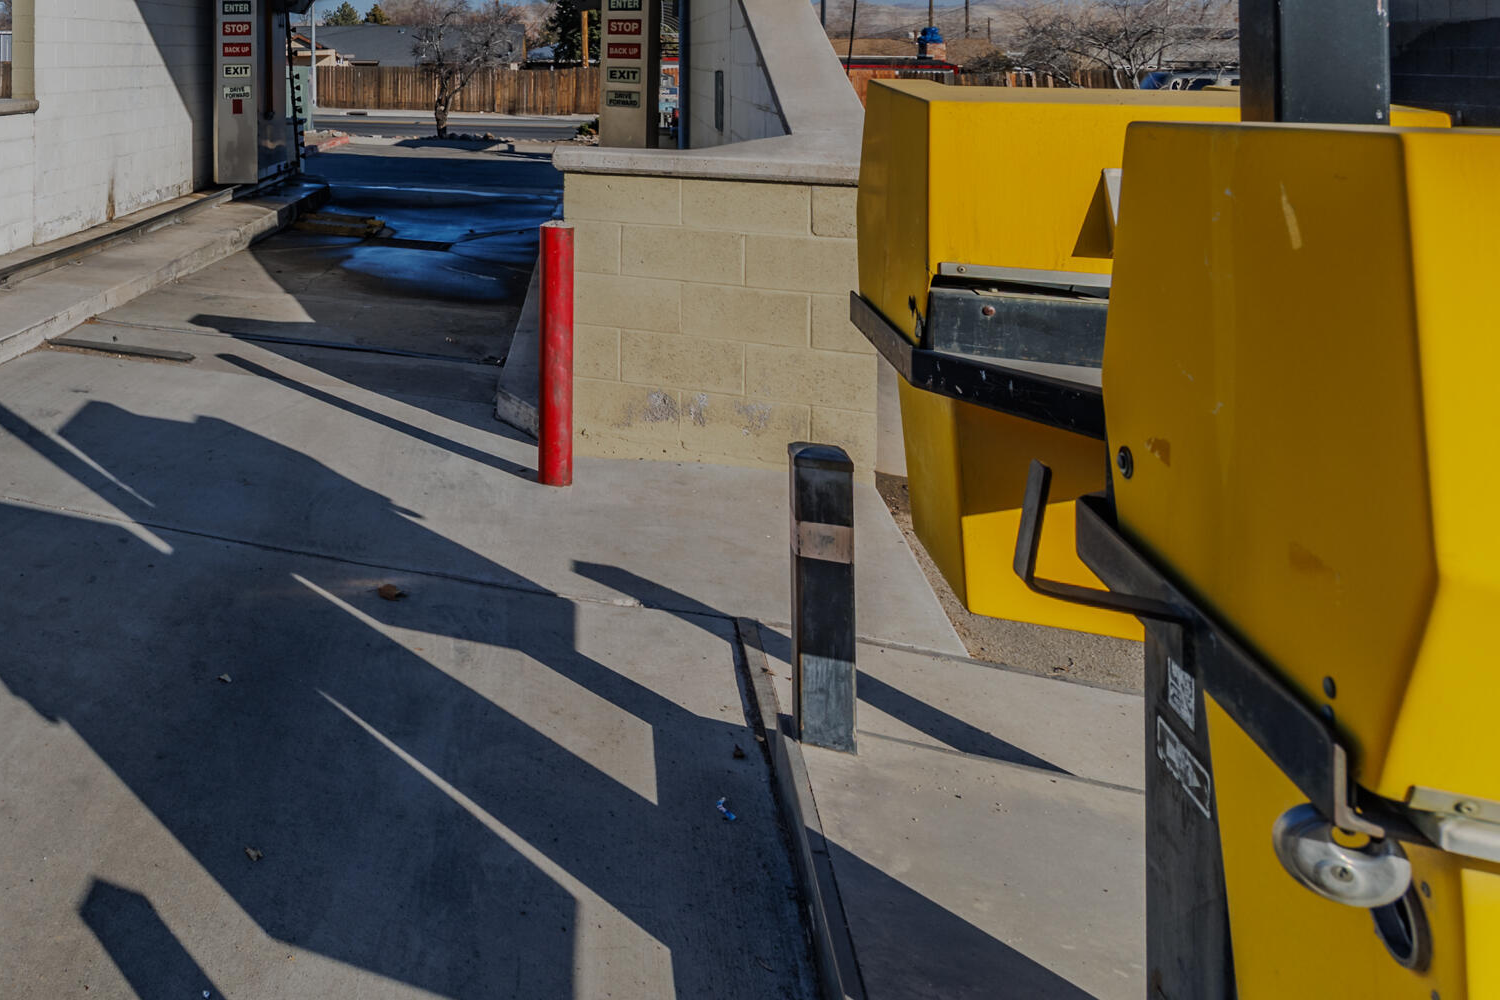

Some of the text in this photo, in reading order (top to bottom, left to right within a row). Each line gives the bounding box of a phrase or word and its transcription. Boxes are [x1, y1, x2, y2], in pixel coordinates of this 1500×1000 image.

[224, 4, 249, 12] ENTER
[610, 0, 639, 9] ENTER
[224, 24, 249, 33] STOP
[610, 22, 639, 32] STOP
[225, 67, 249, 75] EXIT
[610, 70, 638, 80] EXIT
